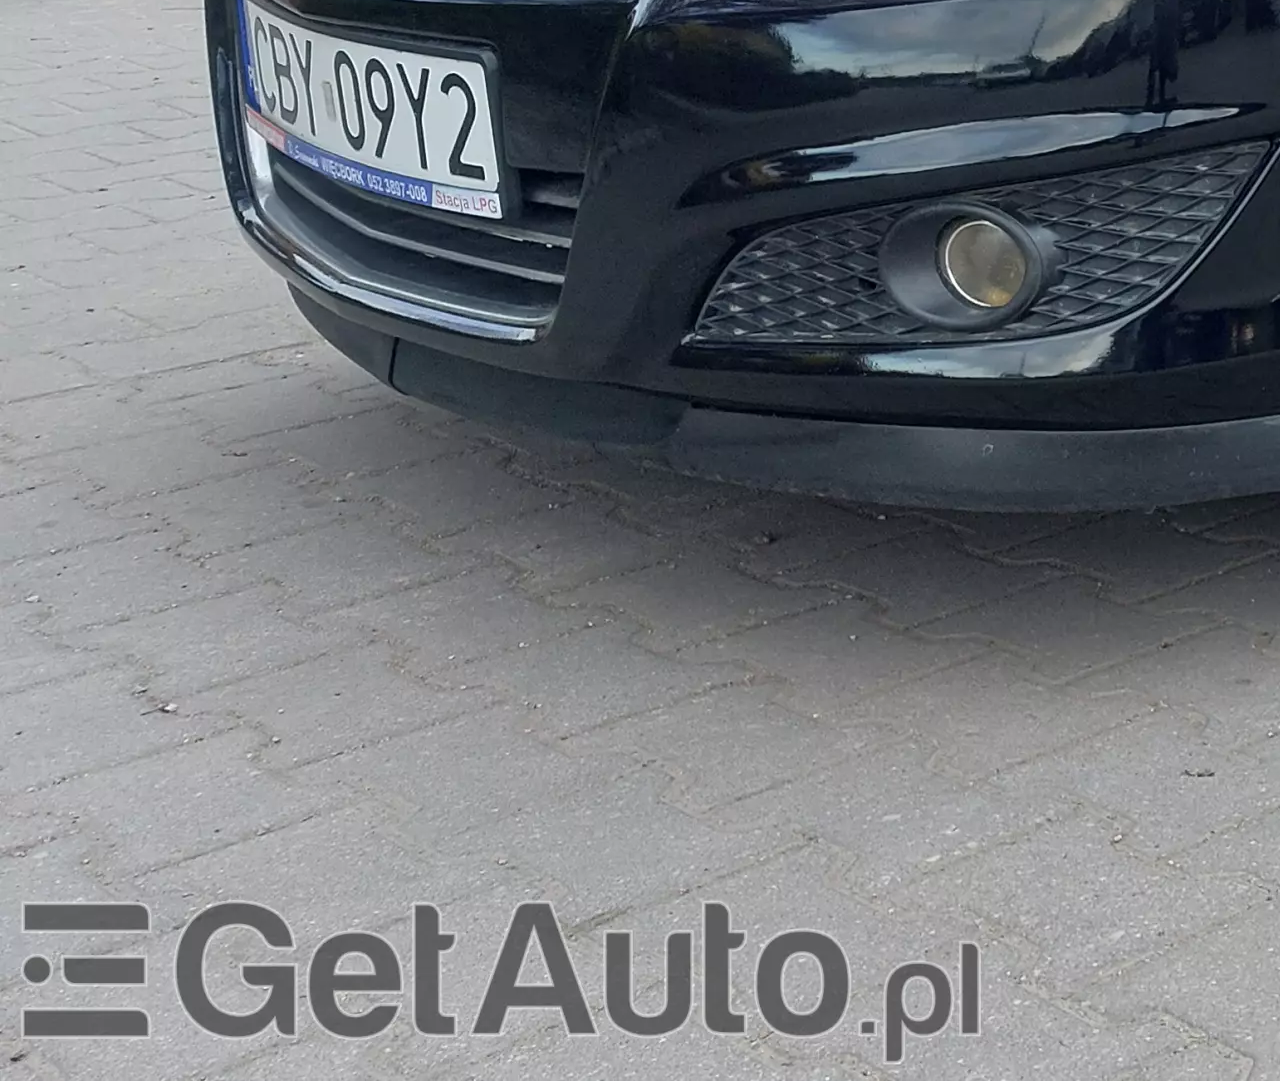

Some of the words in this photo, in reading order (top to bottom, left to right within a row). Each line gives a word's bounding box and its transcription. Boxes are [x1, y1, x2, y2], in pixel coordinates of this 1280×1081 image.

[254, 16, 316, 137] CBY
[334, 50, 485, 181] 09Y2
[366, 173, 384, 193] 052
[435, 189, 470, 212] Stacja
[471, 195, 498, 214] LPG
